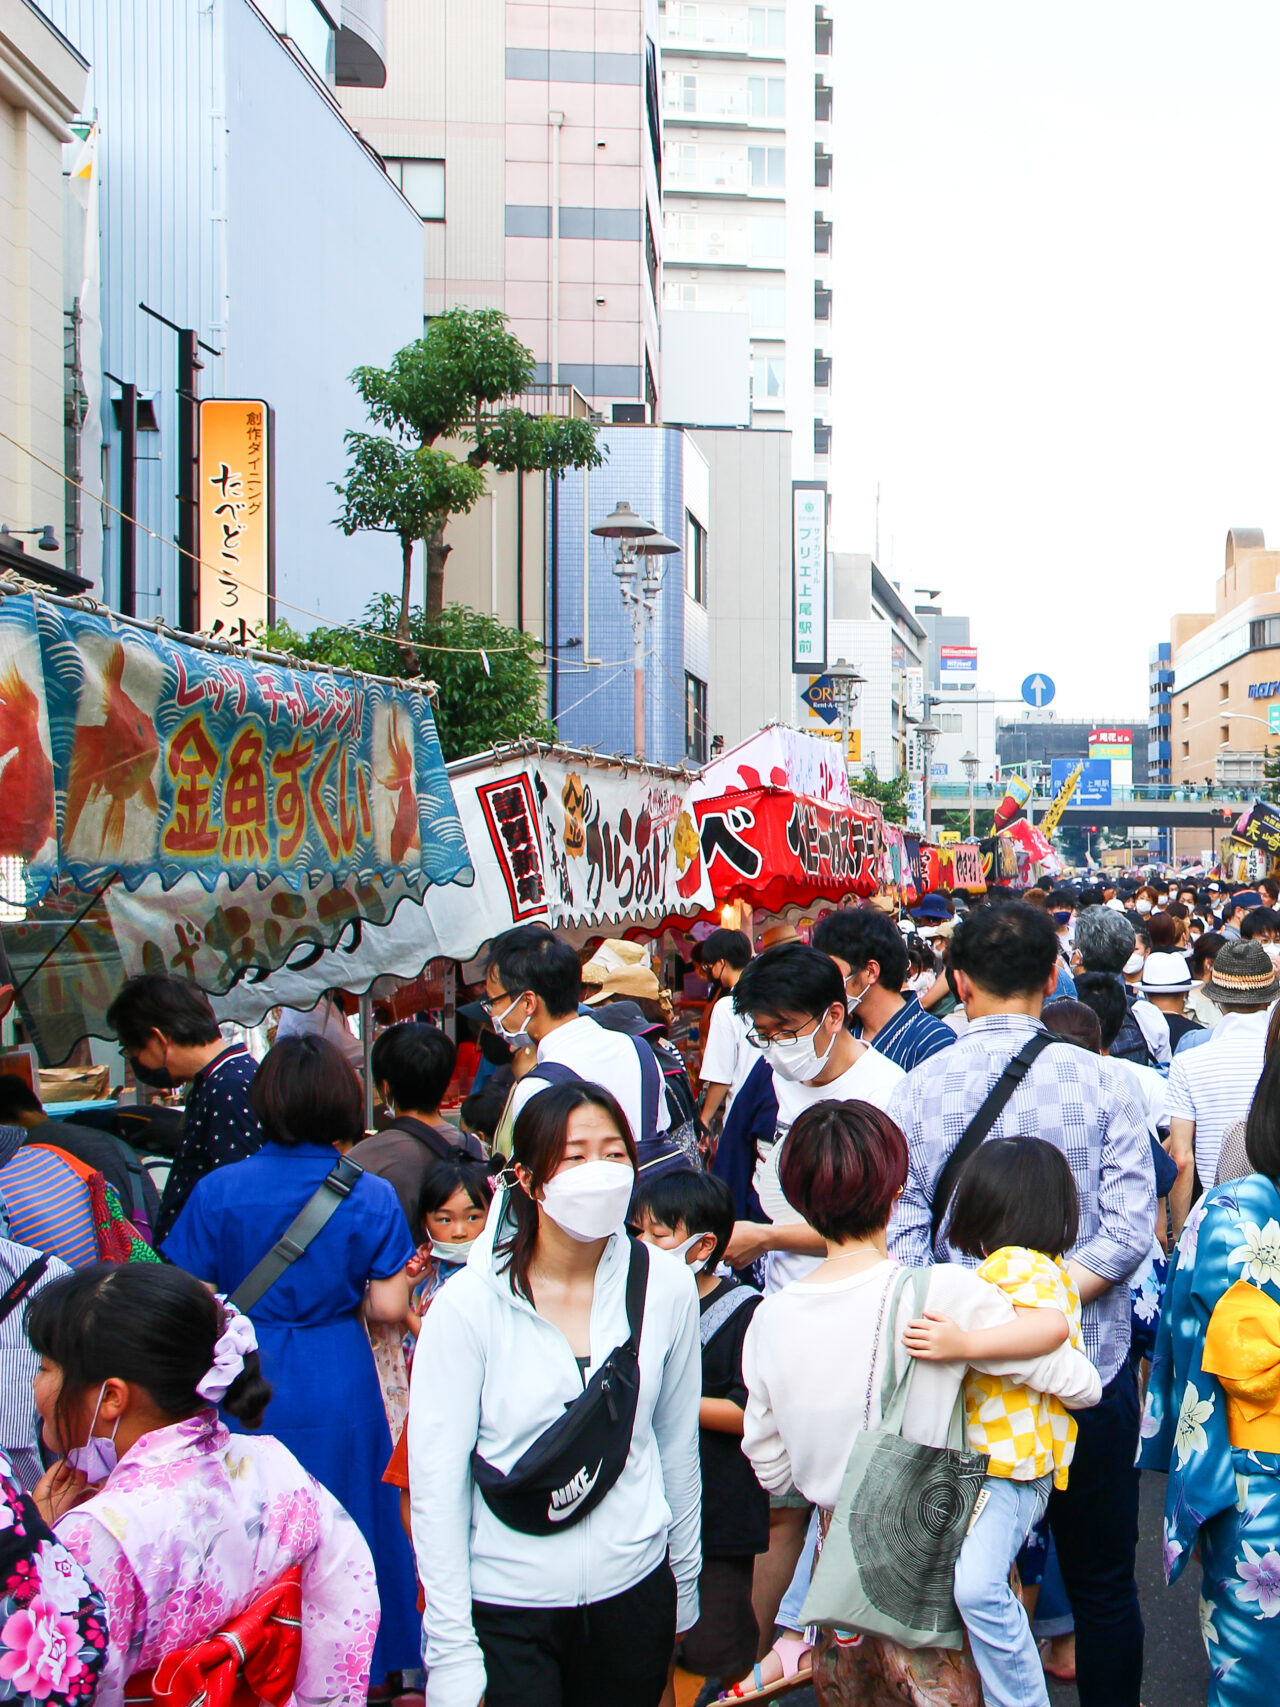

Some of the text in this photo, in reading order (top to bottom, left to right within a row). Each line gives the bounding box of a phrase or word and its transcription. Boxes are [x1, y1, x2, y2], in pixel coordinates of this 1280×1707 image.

[246, 411, 262, 516] 創作ダイニング
[210, 463, 246, 608] たべどころ
[171, 651, 248, 716] レッツ
[161, 713, 372, 864] 金魚すくい
[551, 1466, 591, 1508] NIKE
